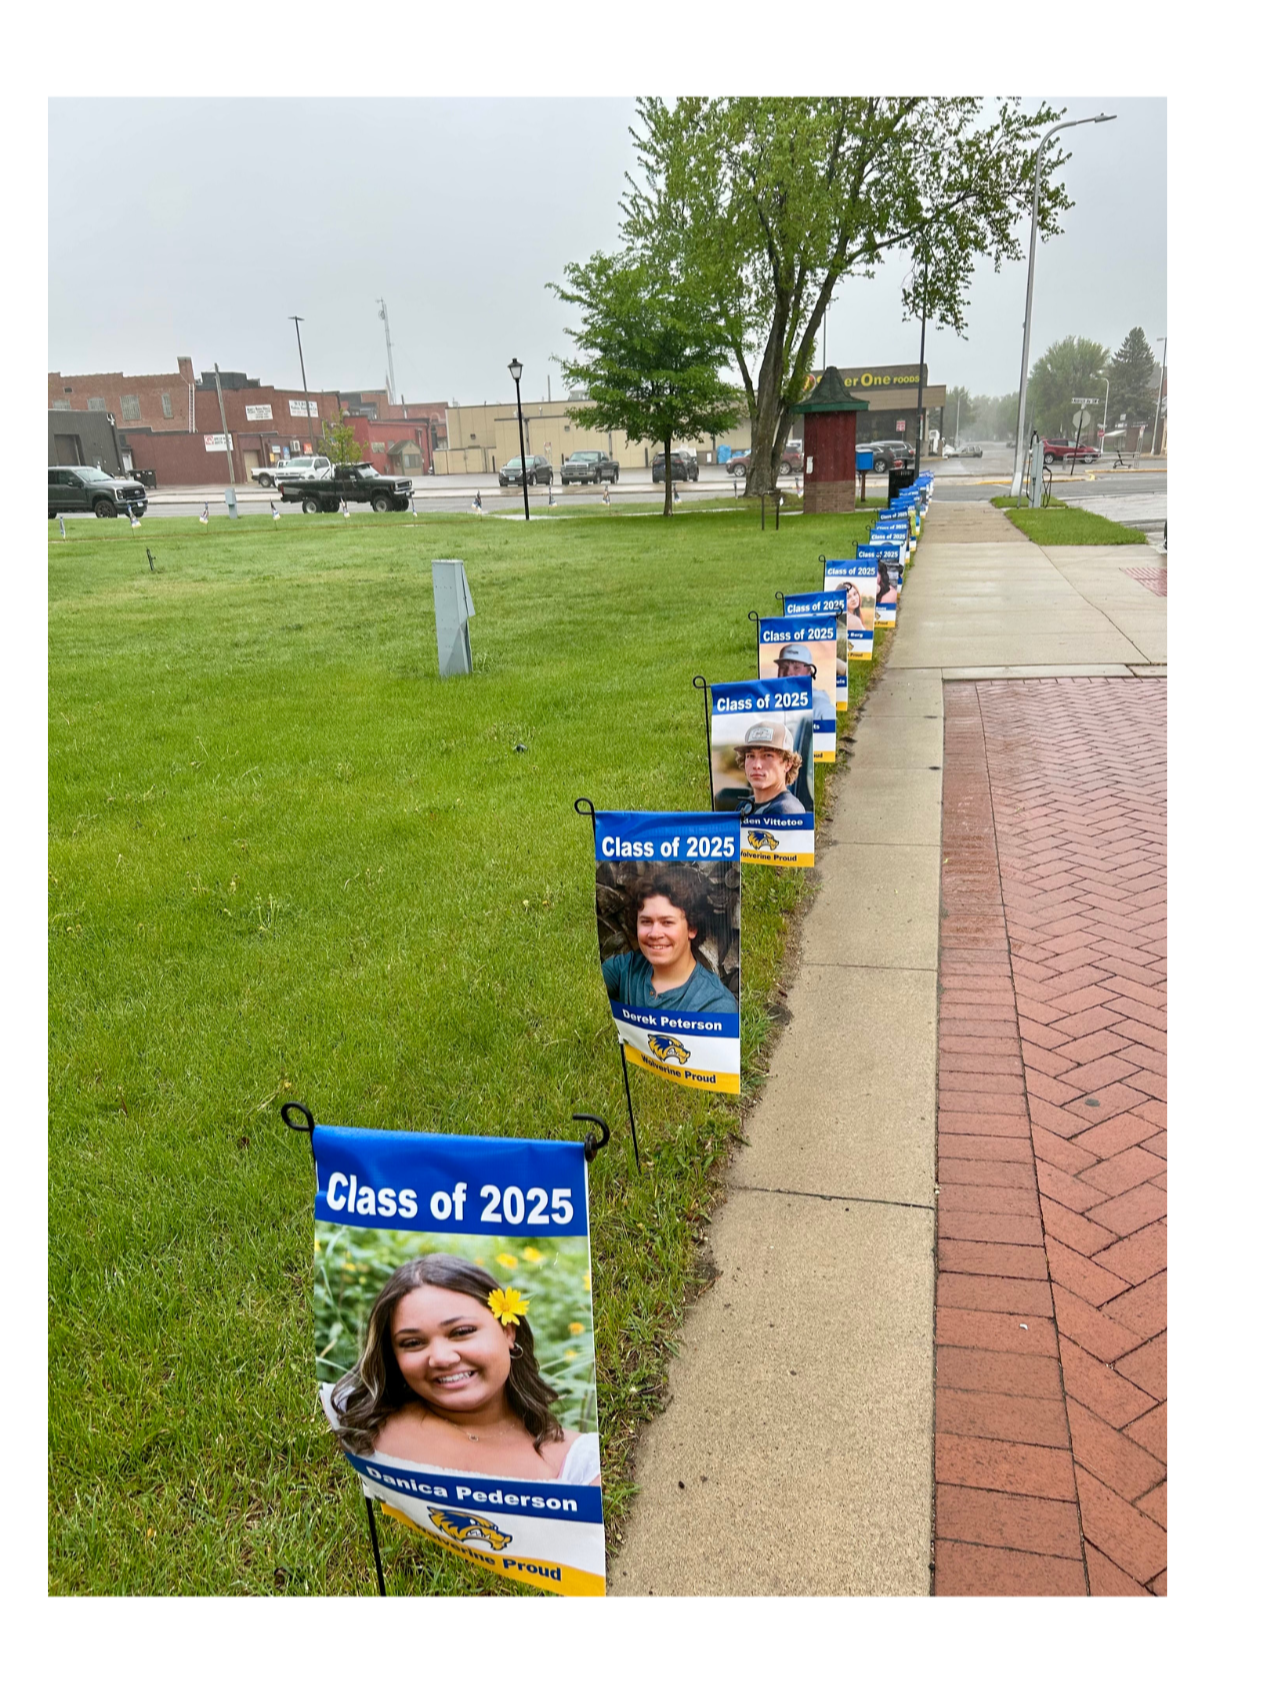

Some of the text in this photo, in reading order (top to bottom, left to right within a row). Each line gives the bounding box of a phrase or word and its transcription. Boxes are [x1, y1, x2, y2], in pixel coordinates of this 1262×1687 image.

[860, 373, 890, 386] One
[893, 376, 920, 384] FOODS
[787, 600, 844, 614] Class of 2025
[763, 628, 834, 642] Class of 2025
[716, 692, 809, 712] Class of 2025
[763, 818, 803, 826] Vittetoe
[602, 836, 735, 858] Class of 2025
[622, 1008, 722, 1031] Derek Peterson
[641, 1054, 716, 1084] Wolverine Proud
[326, 1172, 574, 1224] Class of 2025
[366, 1466, 578, 1512] Danica Pederson
[503, 1558, 562, 1581] Proud
